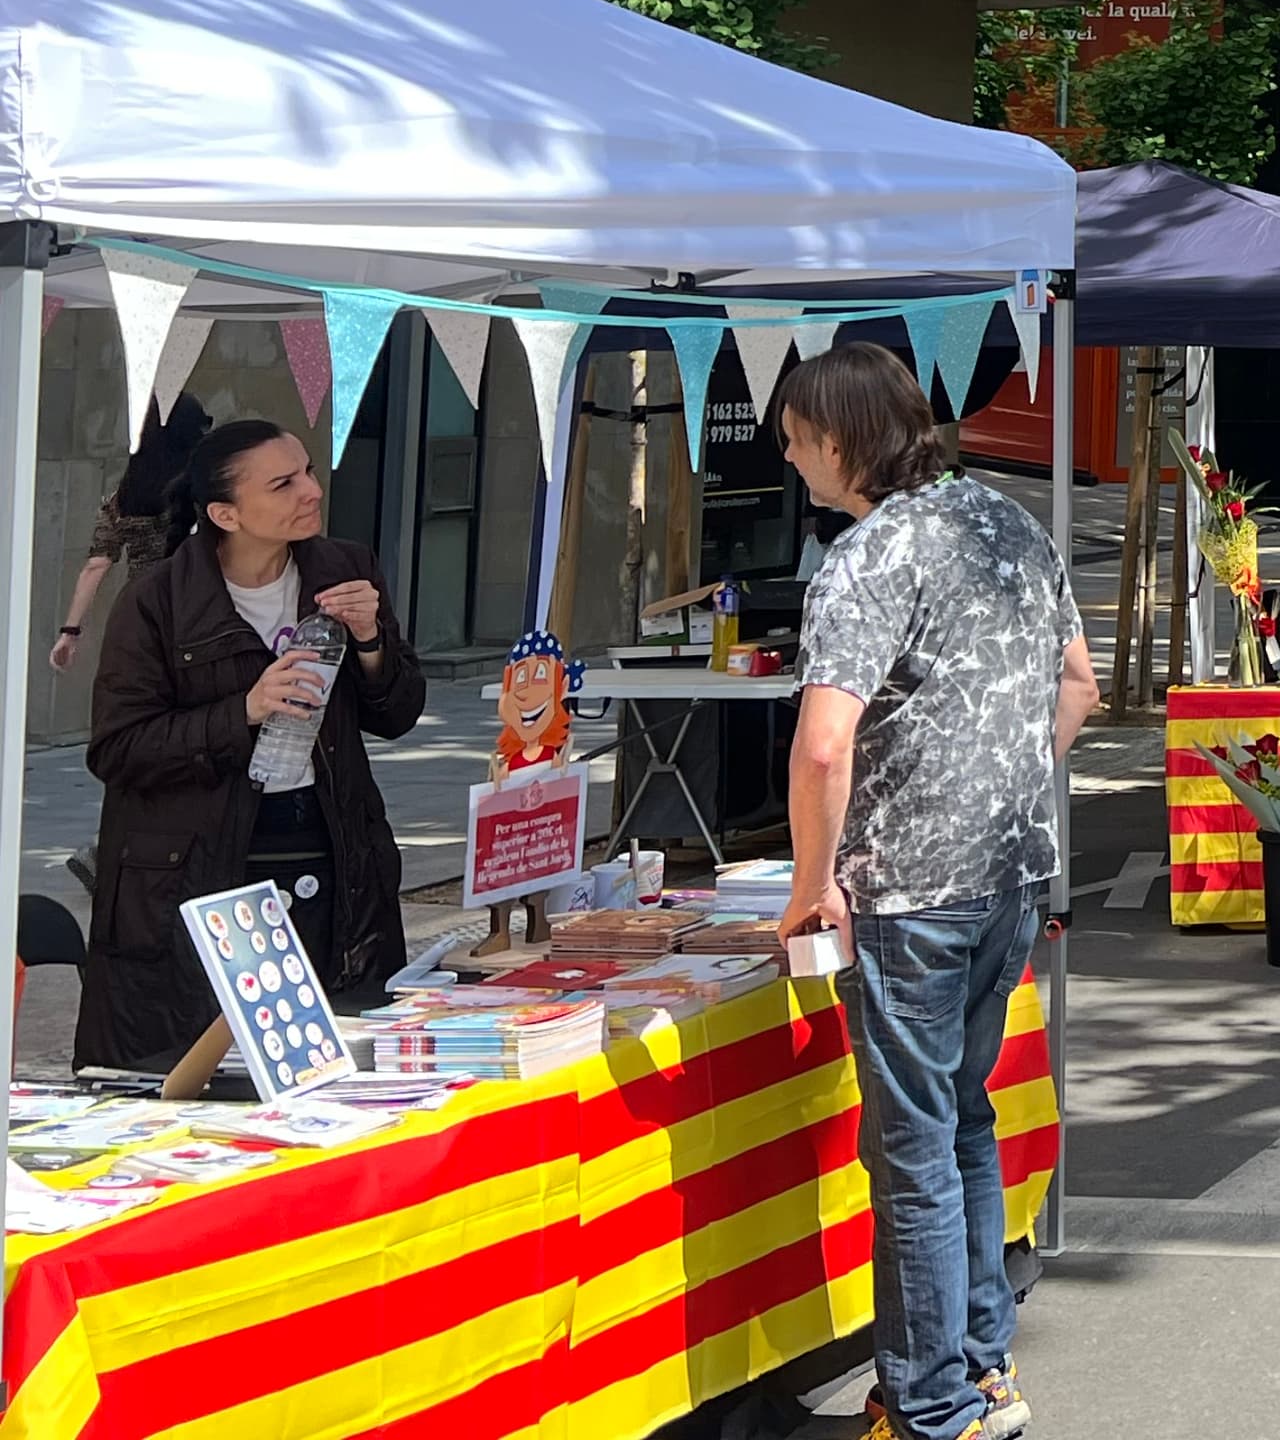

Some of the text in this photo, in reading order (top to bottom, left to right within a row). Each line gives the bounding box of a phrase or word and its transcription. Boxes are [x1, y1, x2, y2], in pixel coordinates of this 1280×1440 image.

[1108, 2, 1125, 17] la
[713, 402, 756, 421] 162 523
[711, 424, 756, 443] 979 527
